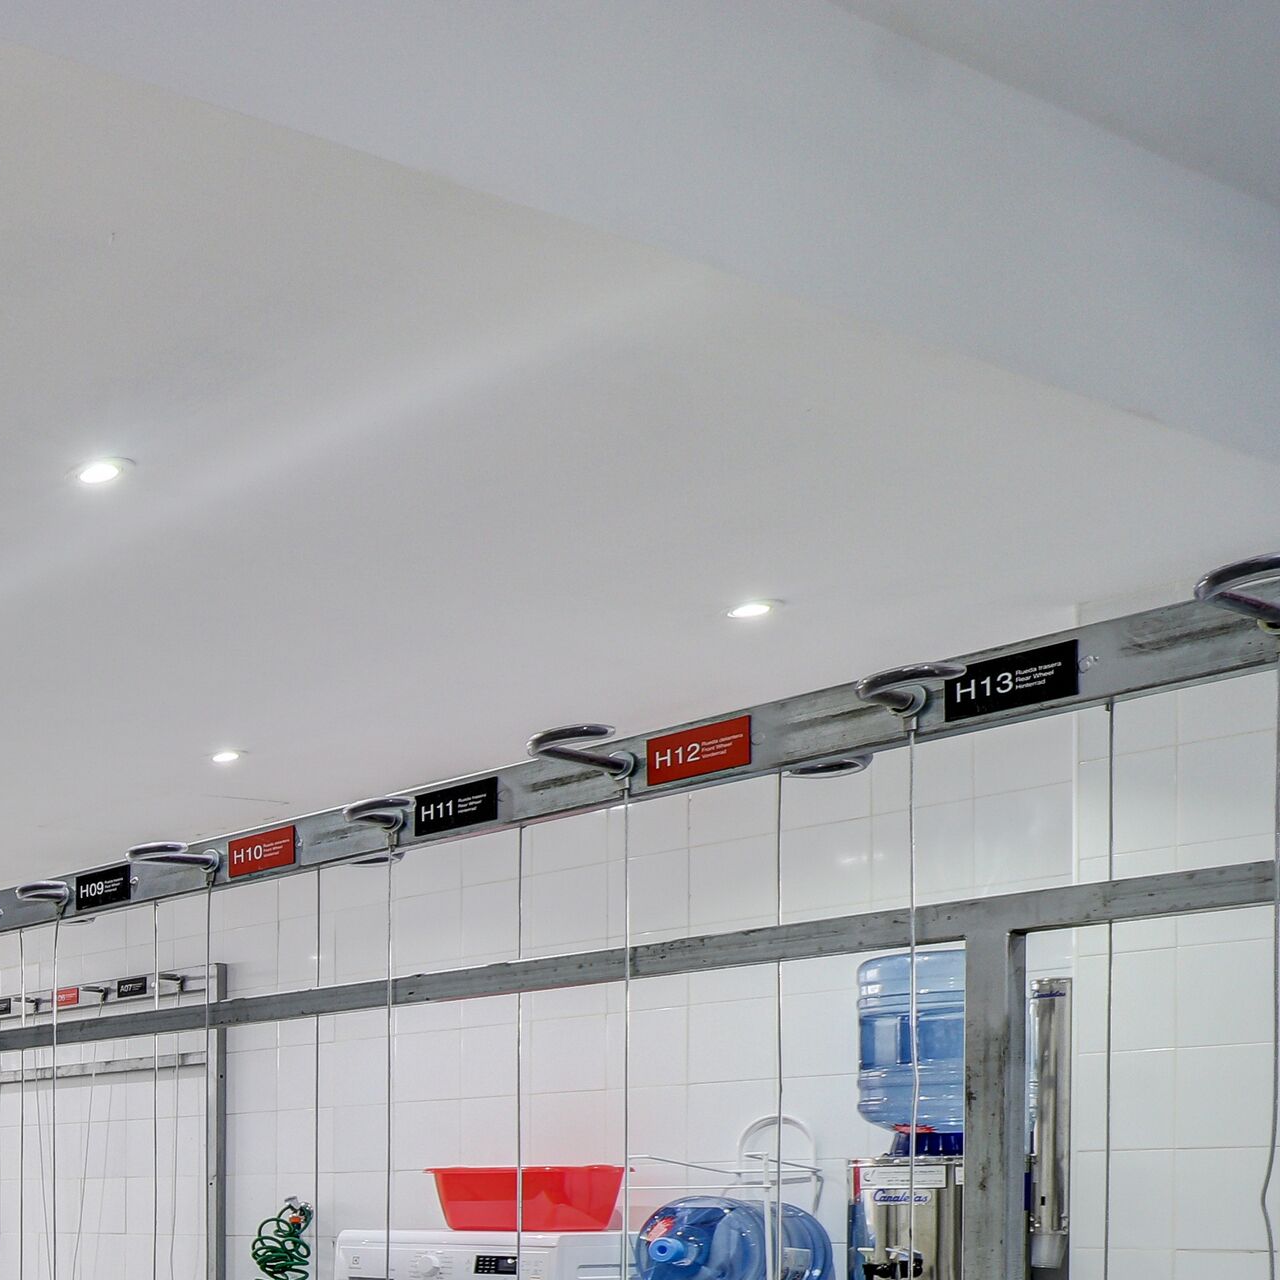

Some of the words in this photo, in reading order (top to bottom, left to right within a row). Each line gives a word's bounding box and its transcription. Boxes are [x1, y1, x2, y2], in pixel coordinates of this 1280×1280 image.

[1015, 674, 1032, 683] Rear
[1033, 669, 1055, 679] Wheel
[956, 672, 1014, 703] H13
[655, 743, 701, 769] H12
[421, 799, 453, 822] H11
[233, 845, 263, 865] H10
[80, 881, 104, 899] H09
[873, 1188, 929, 1203] Canaleas
